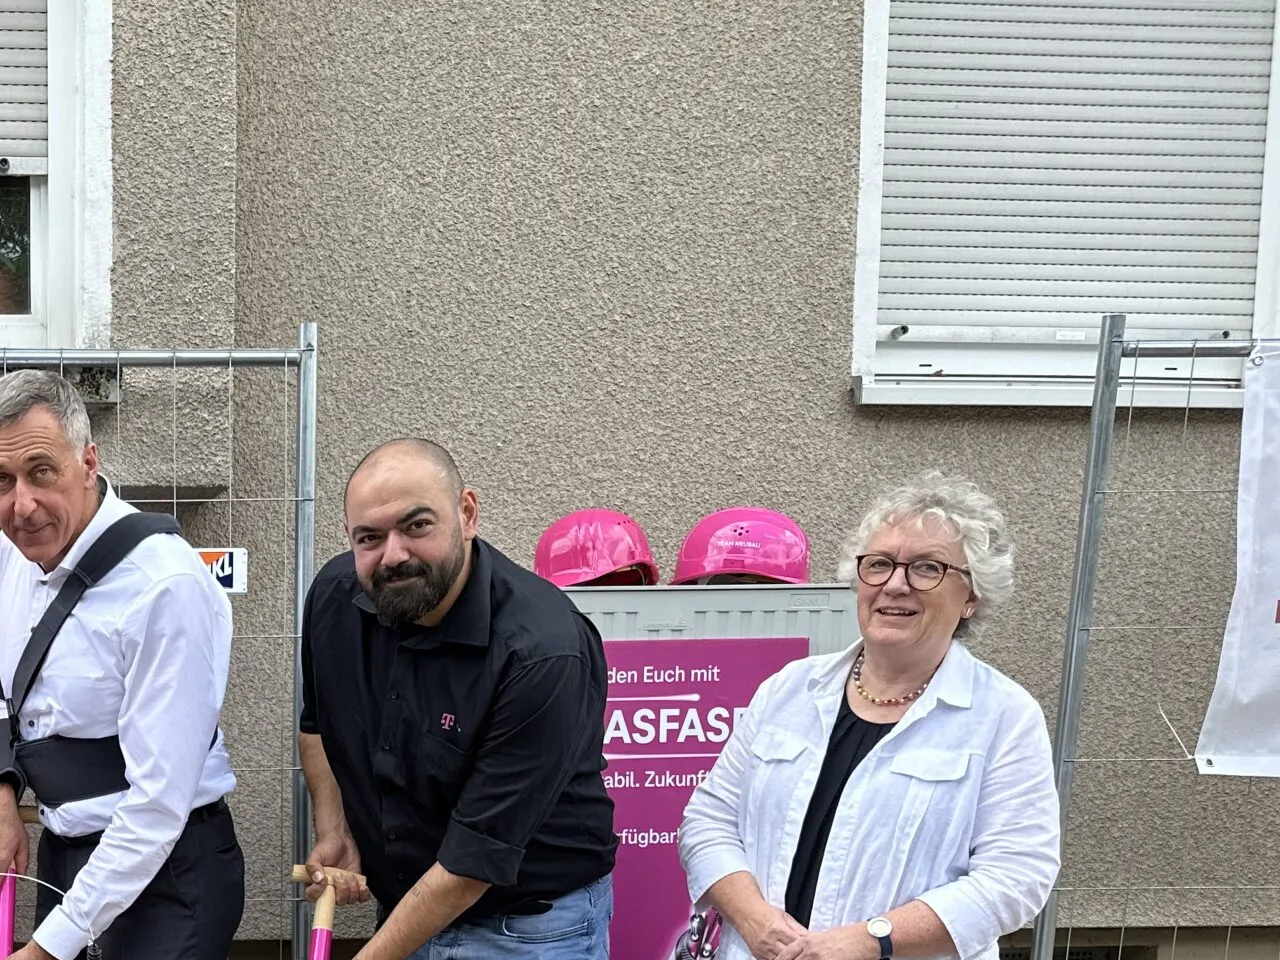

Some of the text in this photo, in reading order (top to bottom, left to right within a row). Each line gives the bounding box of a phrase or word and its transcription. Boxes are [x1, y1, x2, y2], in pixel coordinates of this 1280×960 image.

[607, 665, 720, 684] den Euch mit
[603, 706, 748, 745] ASFAS
[602, 771, 640, 789] abil.
[617, 828, 680, 848] fügbar!
